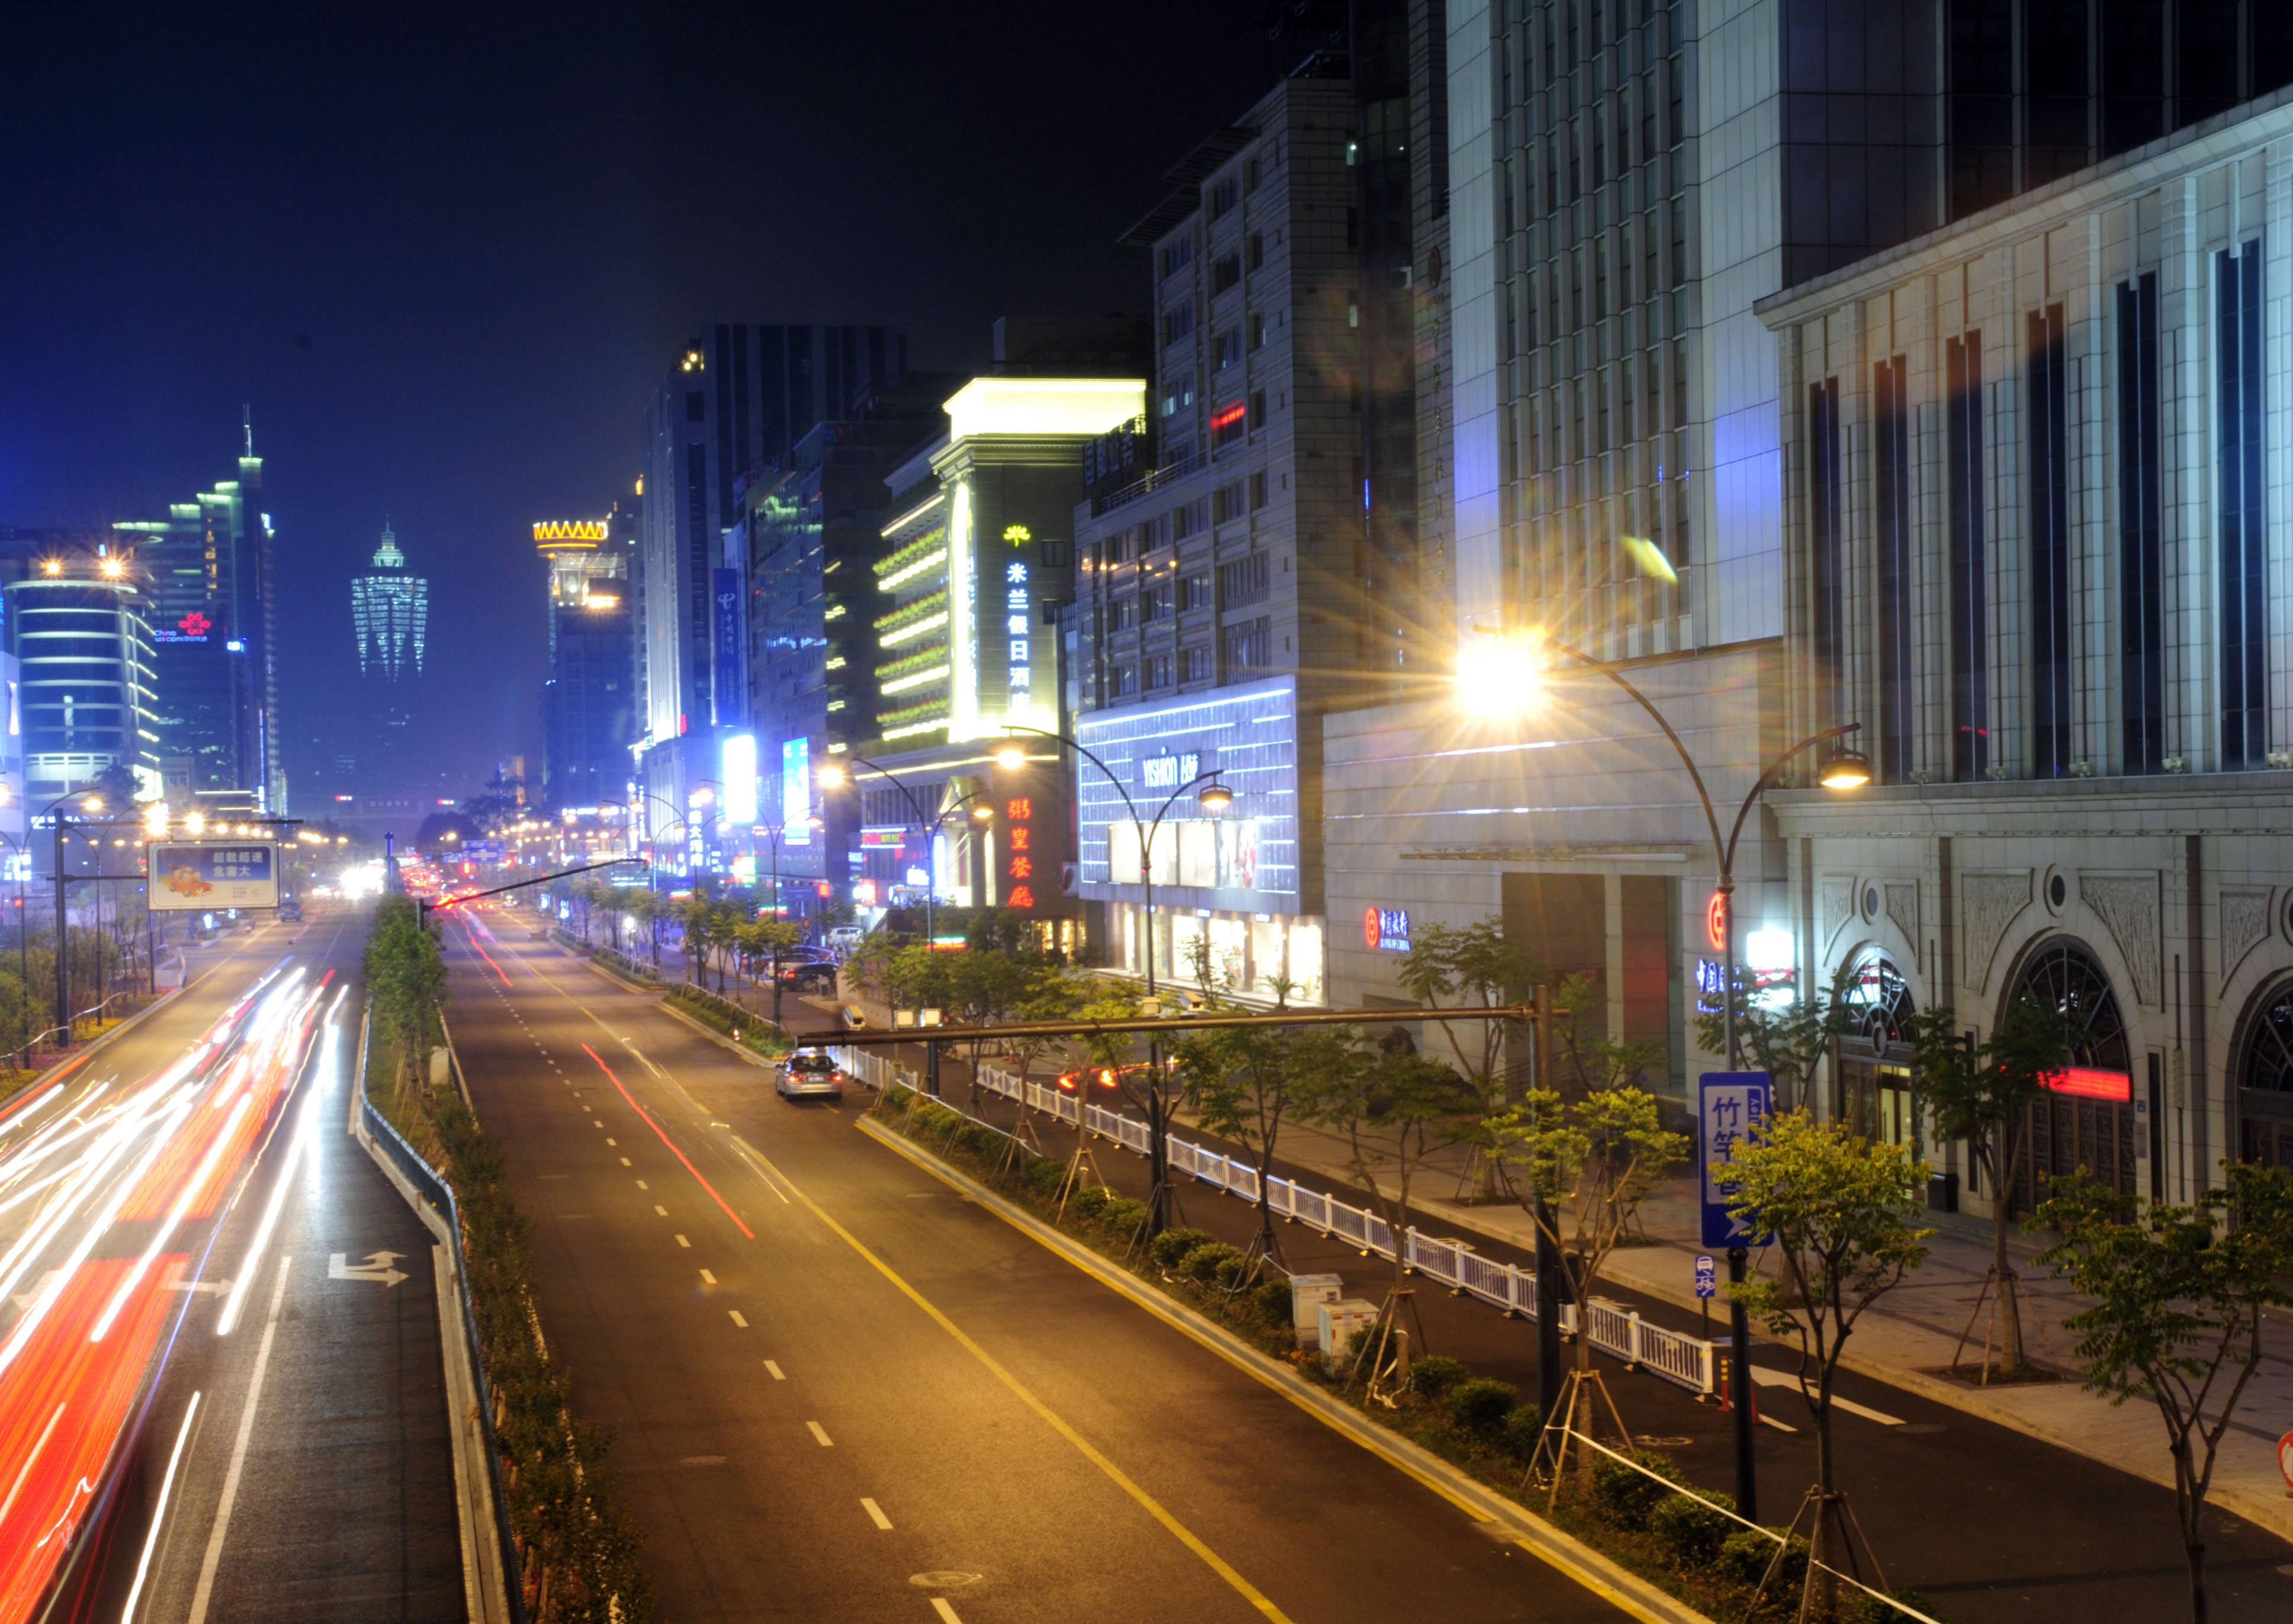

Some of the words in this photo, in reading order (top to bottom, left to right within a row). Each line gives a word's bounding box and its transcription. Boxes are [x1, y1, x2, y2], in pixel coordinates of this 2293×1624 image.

[1143, 747, 1178, 788] YISHION
[213, 851, 264, 863] 超载超速
[214, 866, 251, 877] 危害大
[1749, 1098, 1760, 1125] lley
